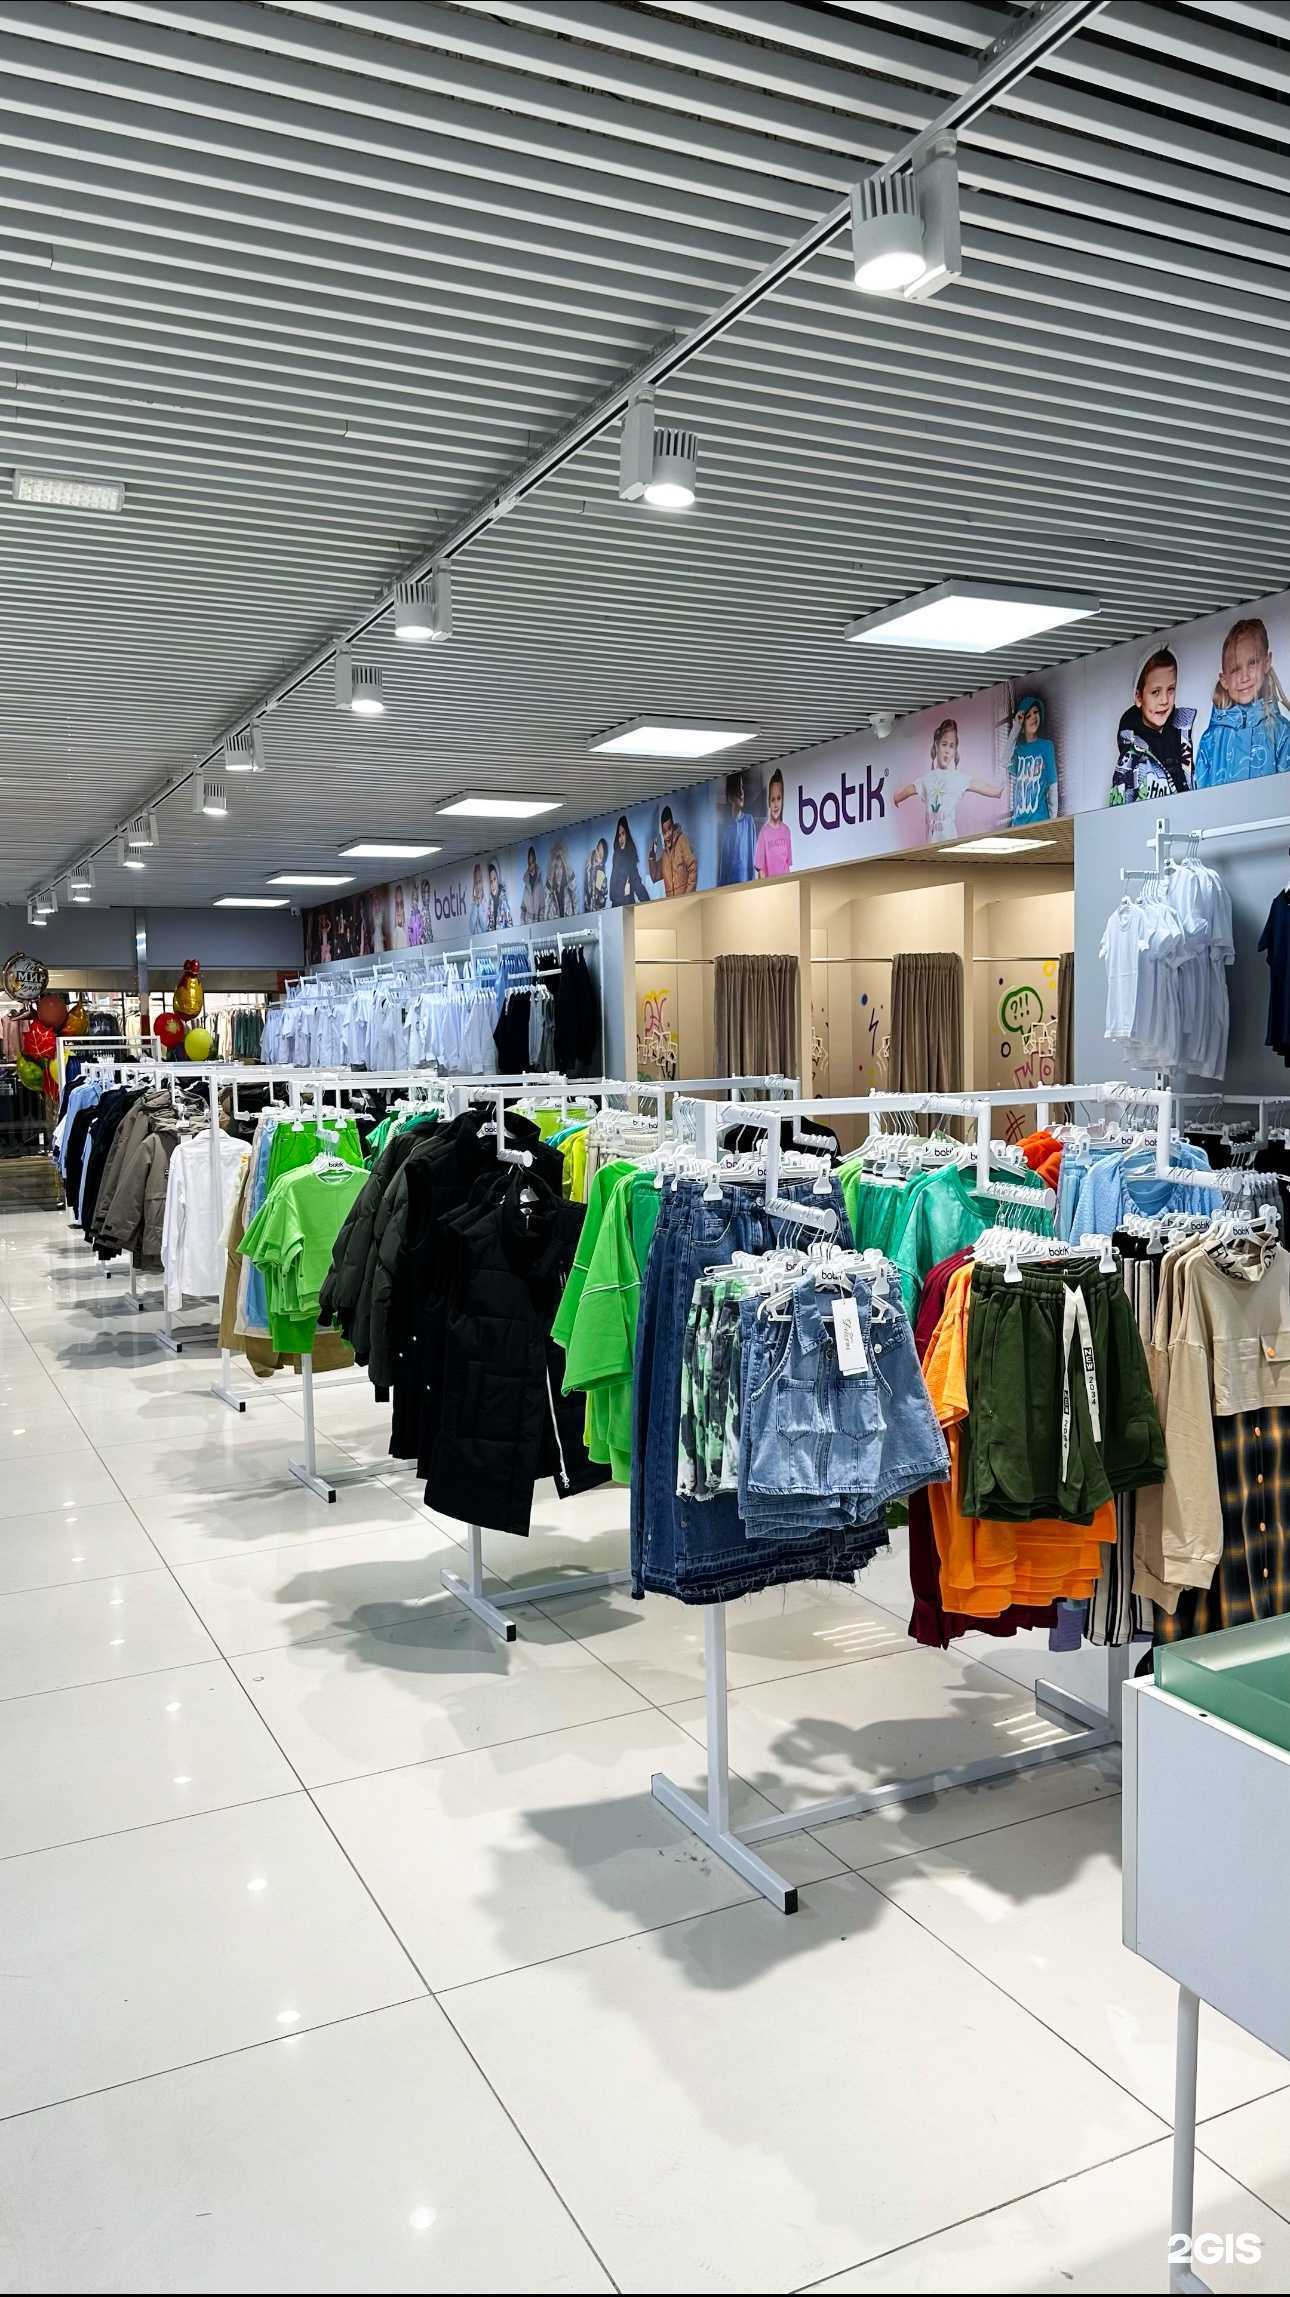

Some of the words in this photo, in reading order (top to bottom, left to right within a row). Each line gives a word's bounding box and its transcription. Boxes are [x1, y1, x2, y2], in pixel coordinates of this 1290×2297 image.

[798, 764, 885, 835] batik
[434, 884, 466, 920] batik
[1083, 1347, 1094, 1371] NEW
